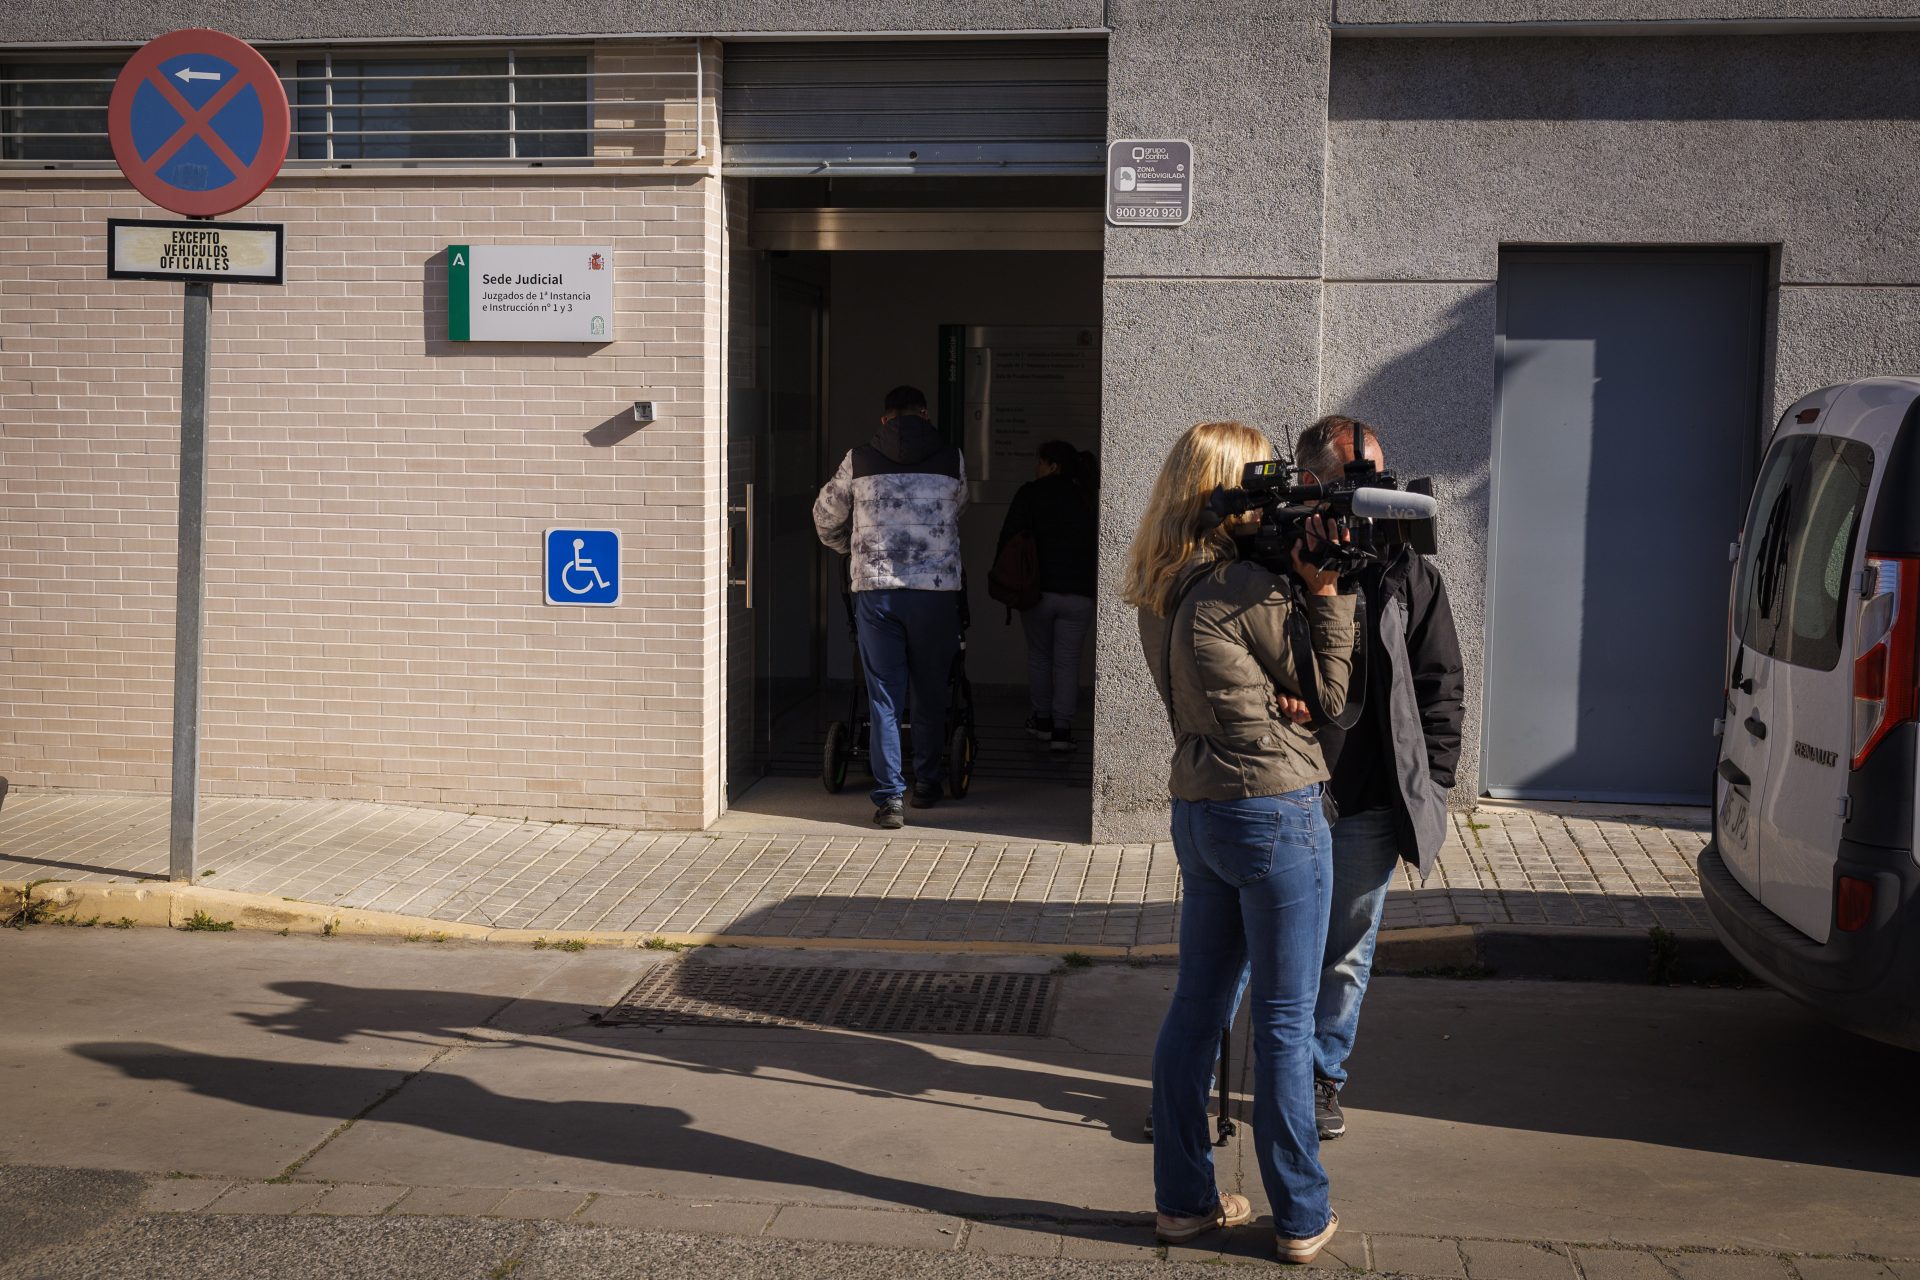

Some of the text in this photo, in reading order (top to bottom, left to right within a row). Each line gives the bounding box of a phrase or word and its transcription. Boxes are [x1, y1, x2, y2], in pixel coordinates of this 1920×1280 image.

[1116, 208, 1182, 218] 900 920 920
[172, 231, 220, 244] EXCEPTO
[164, 243, 228, 258] VEHICULOS
[160, 256, 230, 271] OFICIALES
[482, 274, 563, 285] Sede Judicial
[482, 291, 591, 302] Juzgados de 1ª Instancia
[489, 303, 539, 312] Instrucción
[553, 303, 558, 312] 1
[561, 305, 566, 314] y
[567, 303, 573, 312] 3
[1386, 504, 1417, 519] tve
[1794, 740, 1839, 768] RENAULT
